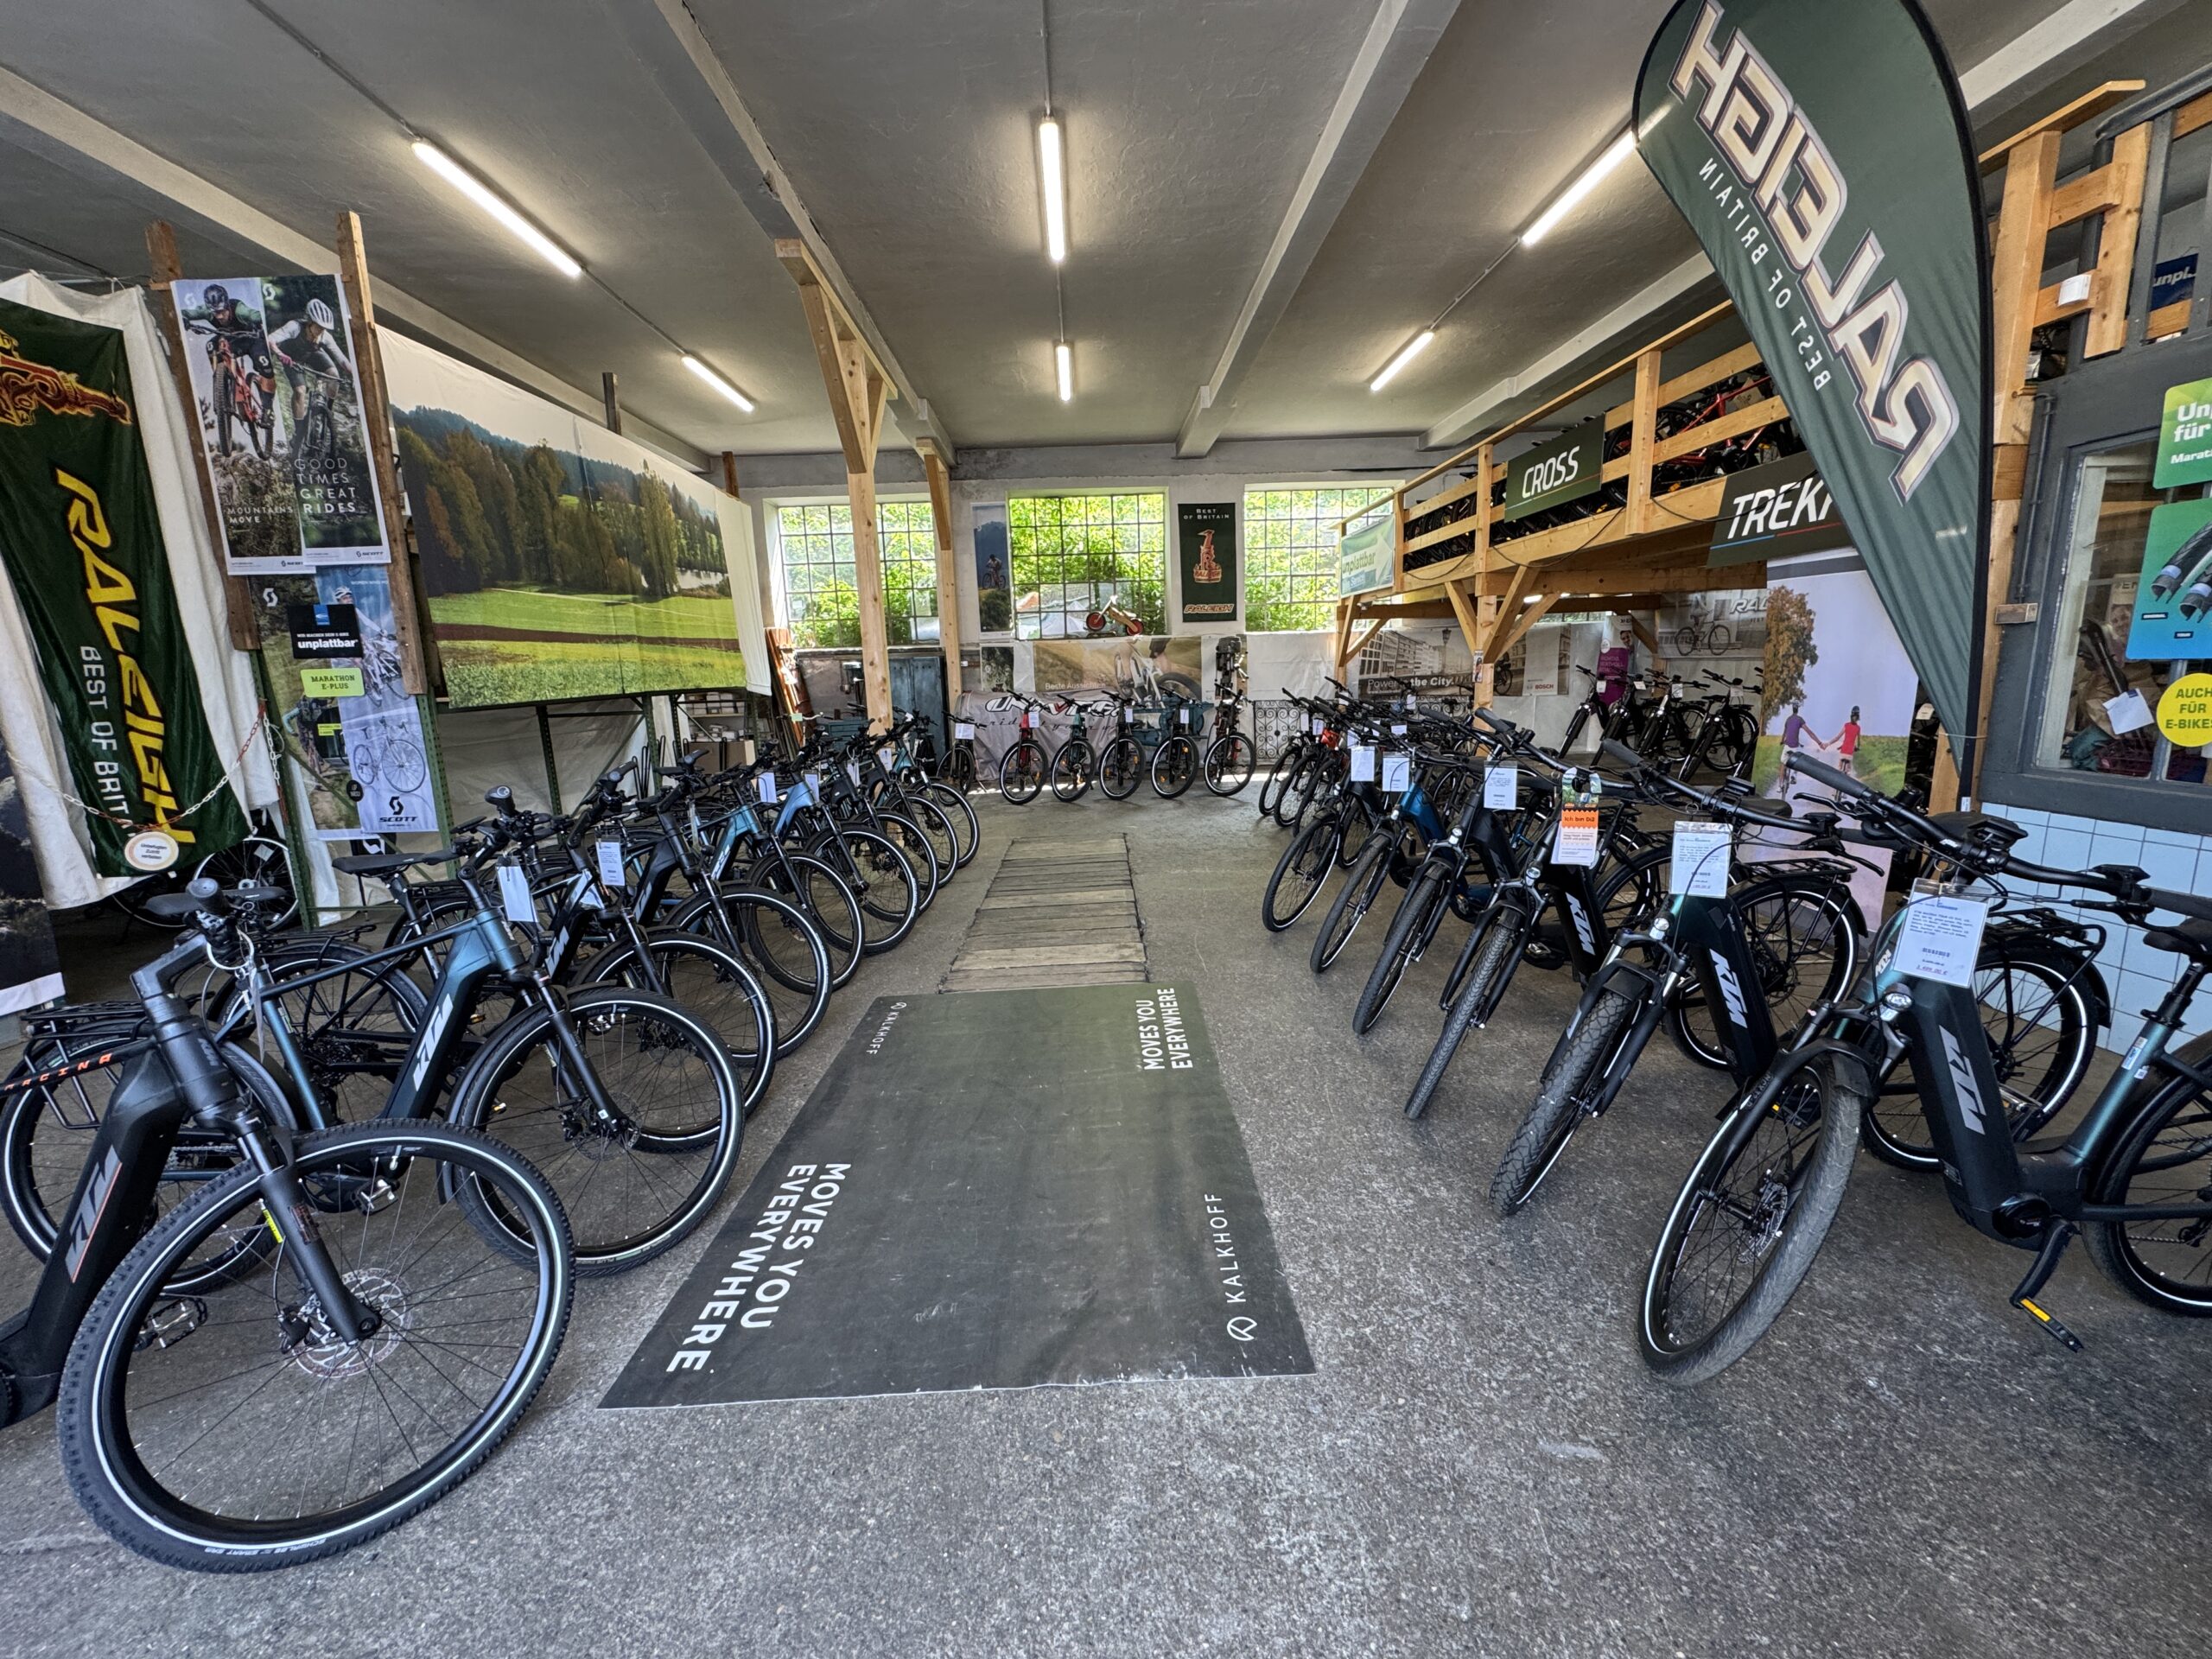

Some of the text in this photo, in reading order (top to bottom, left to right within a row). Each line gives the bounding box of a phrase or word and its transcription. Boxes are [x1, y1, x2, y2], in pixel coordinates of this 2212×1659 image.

[2174, 422, 2211, 442] für
[294, 457, 347, 470] GOOD
[296, 472, 349, 485] TIMES
[1522, 445, 1580, 499] CROSS
[227, 505, 293, 515] MOUNTAINS
[300, 486, 356, 499] GREAT
[303, 502, 356, 513] RIDES
[1184, 604, 1234, 613] RALEIGH
[55, 467, 196, 844] RALEIGH
[297, 639, 356, 651] unplattbar
[1430, 676, 1455, 688] City.
[2176, 688, 2212, 699] AUCH
[2179, 700, 2207, 714] FÜR
[80, 645, 132, 830] BEST OF BRIT
[1565, 892, 1596, 956] KTM
[1708, 948, 1748, 1029] KTM
[412, 993, 454, 1092] KTM
[866, 1011, 899, 1055] KALKHOFF
[1135, 1000, 1166, 1070] MOVES YOU
[1157, 988, 1193, 1069] EVERYWHERE
[1938, 1025, 1986, 1135] KTM
[65, 1144, 121, 1283] KTM
[665, 1164, 817, 1372] EVERYWHERE
[741, 1163, 852, 1328] MOVES YOU
[1205, 1193, 1246, 1303] KALKHOFF
